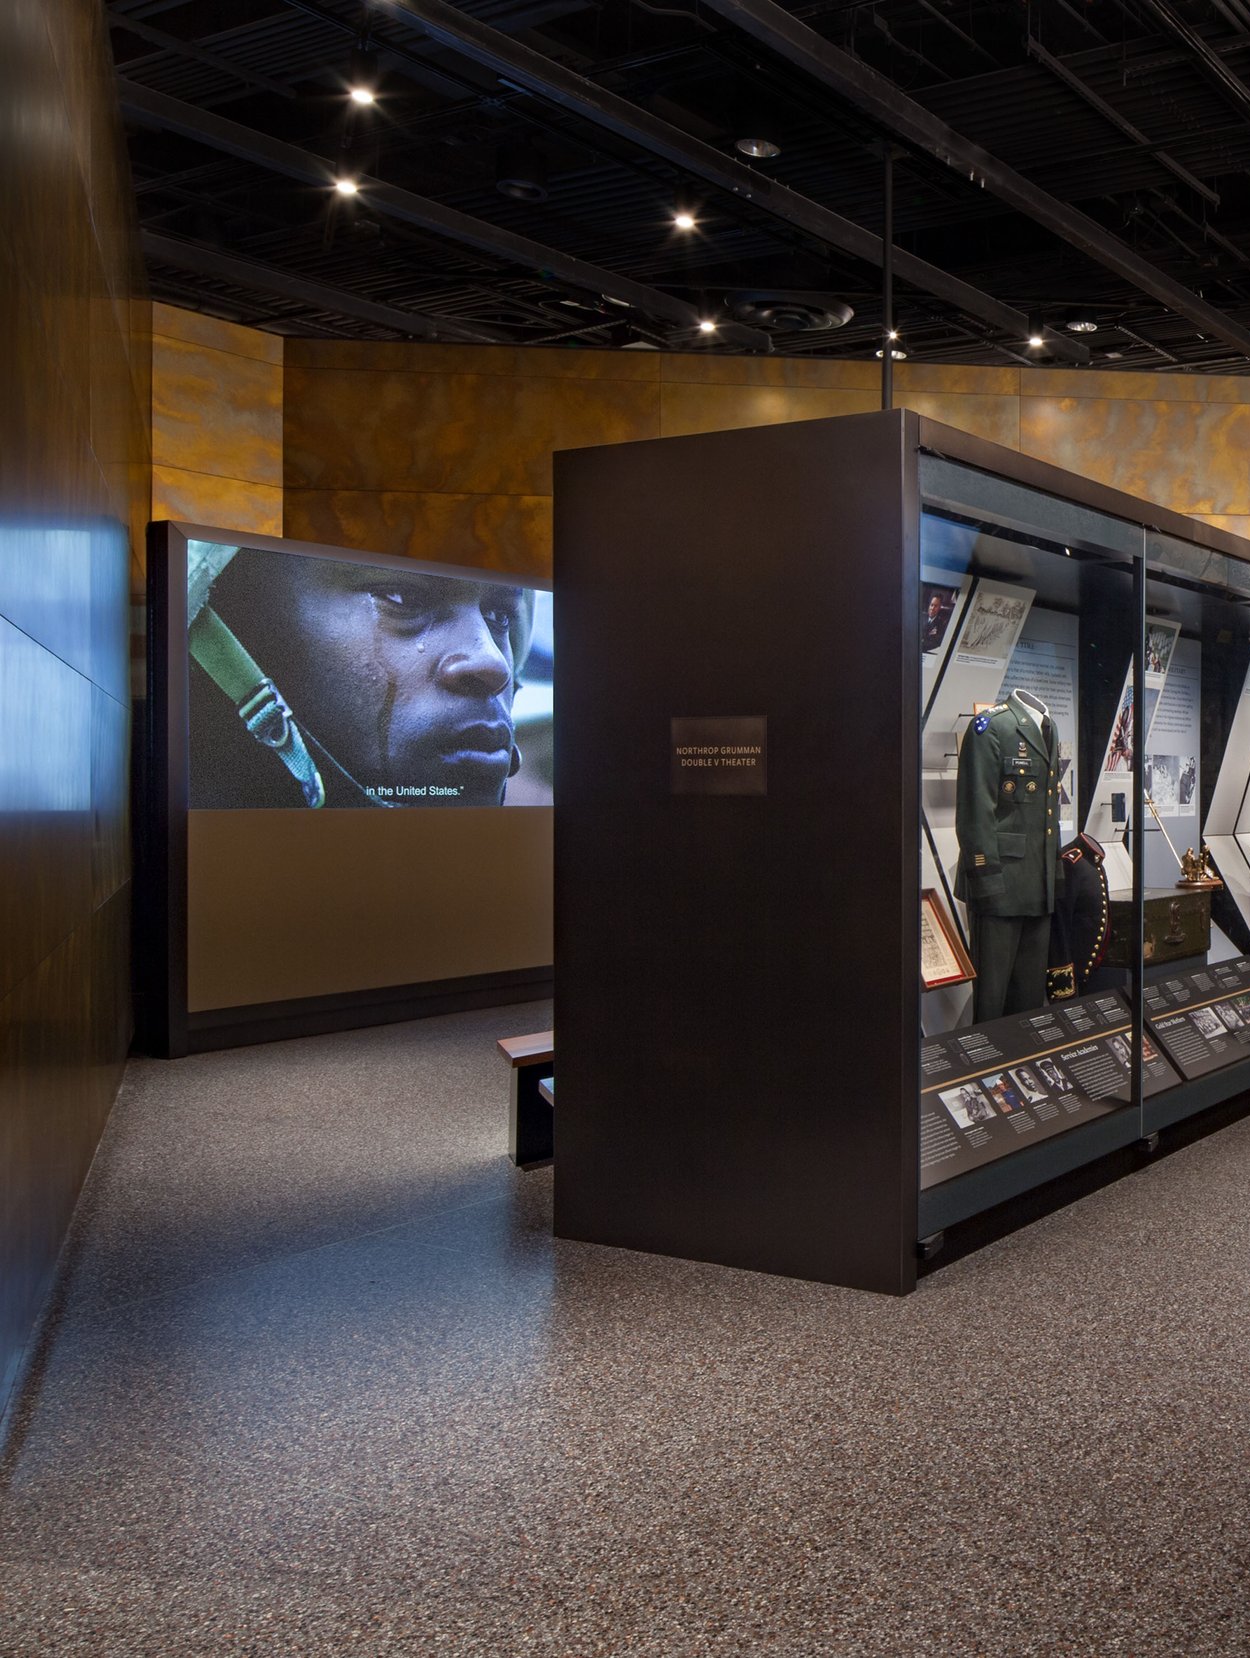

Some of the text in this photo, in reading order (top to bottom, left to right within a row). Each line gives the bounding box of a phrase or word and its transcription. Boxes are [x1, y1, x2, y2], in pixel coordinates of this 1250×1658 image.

[676, 746, 761, 755] NORTHROP GRUMMAN
[681, 758, 756, 767] DOUBLE V THEATER
[366, 785, 375, 796] in
[378, 786, 393, 796] the
[396, 785, 427, 796] United
